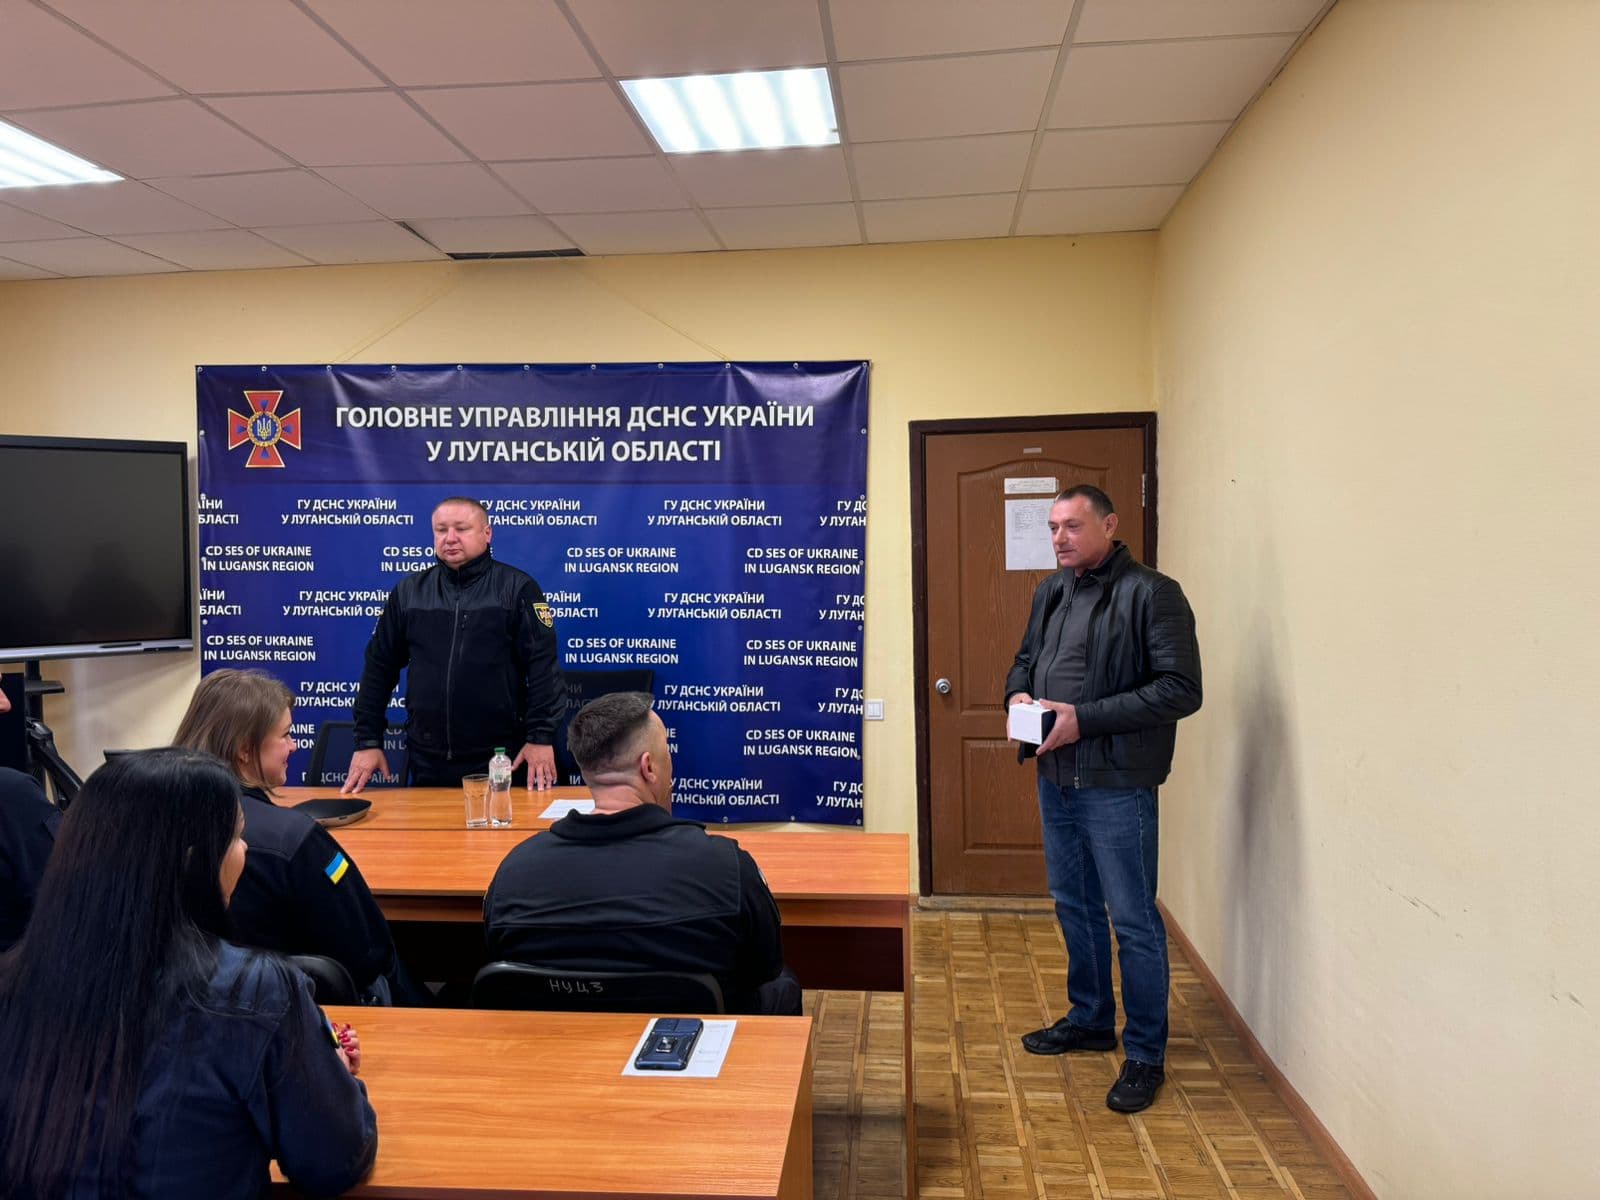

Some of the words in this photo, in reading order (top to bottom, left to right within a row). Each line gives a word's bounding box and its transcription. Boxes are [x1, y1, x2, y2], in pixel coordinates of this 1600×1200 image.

[336, 407, 453, 428] ГОЛОВНЕ
[459, 406, 621, 428] УПРАВЛІННЯ
[627, 406, 697, 432] ДСНС
[703, 401, 814, 427] УКРАЇНИ
[426, 441, 442, 462] У
[447, 437, 604, 462] ЛУГАНСЬКІЙ
[612, 440, 720, 461] ОБЛАСТІ
[297, 499, 312, 510] ГУ
[313, 499, 347, 511] ДСНС
[348, 497, 397, 510] УКРАЇНИ
[495, 500, 528, 512] ДСНС
[530, 498, 581, 510] УКРАЇНИ
[664, 500, 679, 511] ГУ
[680, 500, 713, 512] ДСНС
[714, 498, 765, 511] УКРАЇНИ
[837, 501, 852, 511] ГУ
[281, 514, 290, 525] У
[290, 512, 363, 525] ЛУГАНСЬКІЙ
[364, 514, 414, 525] ОБЛАСТІ
[488, 513, 545, 526] ГАНСЬКІЙ
[546, 515, 598, 526] ОБЛАСТІ
[647, 515, 656, 526] У
[657, 513, 729, 526] ЛУГАНСЬКІЙ
[730, 515, 782, 526] ОБЛАСТІ
[820, 516, 828, 526] У
[205, 546, 223, 556] CD
[225, 546, 244, 556] SES
[245, 546, 261, 556] OF
[262, 546, 312, 556] UKRAINE
[383, 547, 400, 557] CD
[402, 547, 422, 557] SES
[566, 547, 583, 558] CD
[585, 547, 605, 558] SES
[607, 547, 624, 558] OF
[627, 547, 677, 558] UKRAINE
[746, 548, 763, 559] CD
[766, 548, 786, 559] SES
[788, 548, 805, 559] OF
[807, 548, 859, 559] UKRAINE
[203, 561, 216, 571] IN
[219, 561, 270, 571] LUGANSK
[272, 561, 315, 571] REGION
[381, 562, 393, 572] IN
[396, 562, 438, 572] LUGAN
[564, 563, 577, 573] IN
[579, 563, 634, 573] LUGANSK
[636, 563, 679, 573] REGION
[744, 564, 757, 575] IN
[759, 564, 815, 575] LUGANSK
[816, 564, 860, 575] REGION
[299, 591, 313, 601] ГУ
[314, 591, 346, 603] ДСНС
[348, 589, 392, 601] УКРАЇН
[543, 590, 581, 603] РАЇНИ
[664, 593, 680, 603] ГУ
[680, 593, 712, 605] ДСНС
[713, 591, 765, 604] УКРАЇНИ
[836, 594, 850, 605] ГУ
[283, 605, 291, 616] У
[292, 604, 363, 616] ЛУГАНСЬКІЙ
[647, 607, 656, 618] У
[657, 606, 729, 620] ЛУГАНСЬКІЙ
[730, 608, 782, 620] ОБЛАСТІ
[819, 609, 827, 620] У
[206, 635, 224, 646] CD
[226, 635, 246, 646] SES
[248, 635, 263, 646] OF
[264, 635, 314, 646] UKRAINE
[567, 638, 583, 649] CD
[585, 638, 606, 649] SES
[608, 638, 625, 649] OF
[627, 638, 677, 649] UKRAINE
[746, 639, 763, 650] CD
[765, 639, 786, 650] SES
[788, 639, 804, 650] OF
[806, 639, 857, 651] UKRAINE
[204, 650, 217, 661] IN
[220, 650, 272, 661] LUGANSK
[273, 650, 316, 661] REGION
[565, 653, 578, 664] IN
[580, 653, 634, 664] LUGANSK
[636, 653, 679, 664] REGION
[744, 655, 756, 666] IN
[758, 655, 813, 666] LUGANSK
[814, 655, 858, 667] REGION
[300, 681, 314, 692] ГУ
[315, 681, 347, 694] ДСНС
[664, 685, 679, 696] ГУ
[680, 685, 711, 698] ДСНС
[712, 684, 764, 697] УКРАЇНИ
[835, 688, 849, 698] ГУ
[294, 696, 355, 707] ЛУГАНСЬКІ
[657, 698, 728, 712] ЛУГАНСЬКІЙ
[730, 700, 781, 712] ОБЛАСТІ
[818, 702, 826, 713] У
[289, 723, 315, 734] AINE
[746, 729, 762, 741] CD
[764, 729, 785, 741] SES
[787, 729, 803, 741] OF
[805, 729, 855, 742] UKRAINE
[743, 745, 755, 757] IN
[757, 745, 813, 757] LUGANSK
[814, 745, 858, 759] REGION
[678, 778, 710, 790] ДСНС
[711, 777, 763, 790] УКРАЇНИ
[833, 781, 848, 792] ГУ
[671, 792, 727, 806] ГАНСЬКІЙ
[728, 793, 780, 806] ОБЛАСТІ
[816, 795, 825, 806] У
